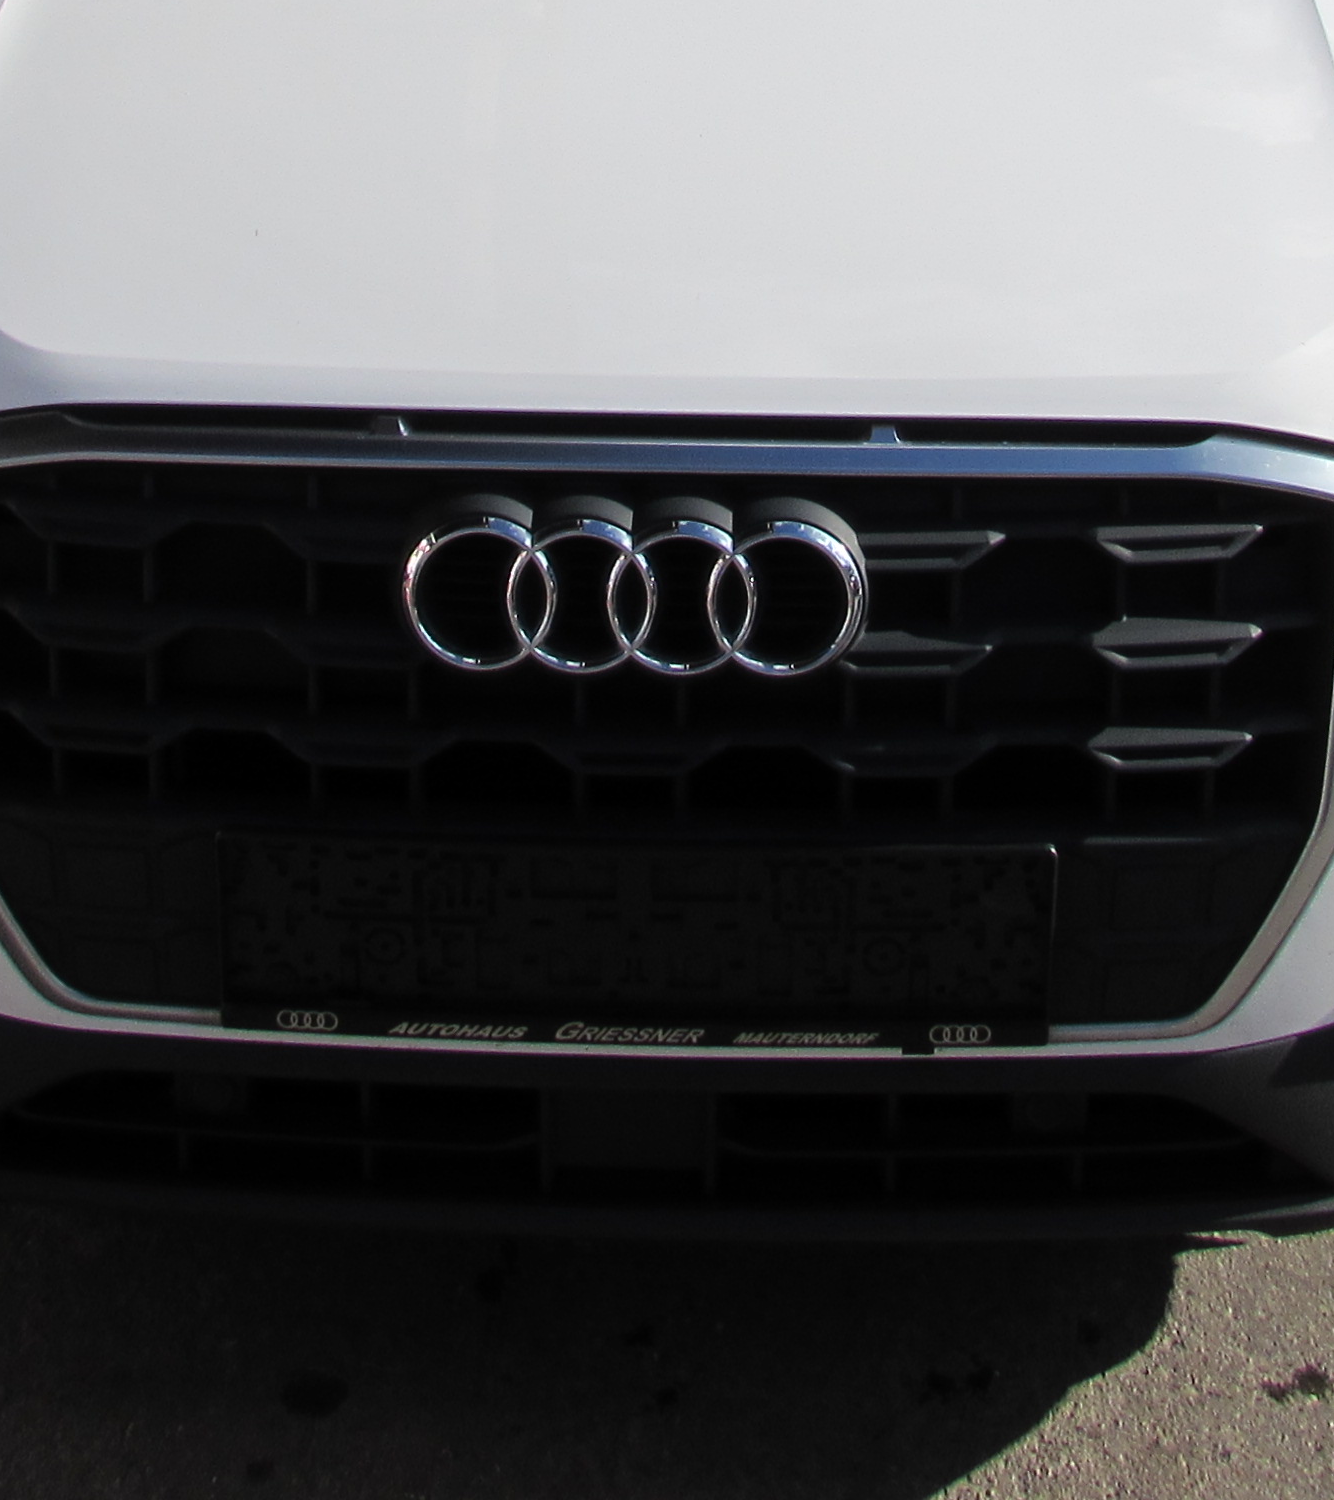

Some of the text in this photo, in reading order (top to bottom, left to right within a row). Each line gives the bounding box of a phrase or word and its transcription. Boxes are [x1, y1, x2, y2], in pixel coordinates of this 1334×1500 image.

[388, 1020, 880, 1046] AUTOHAUS GRIESSNER MAUTERNDORF
